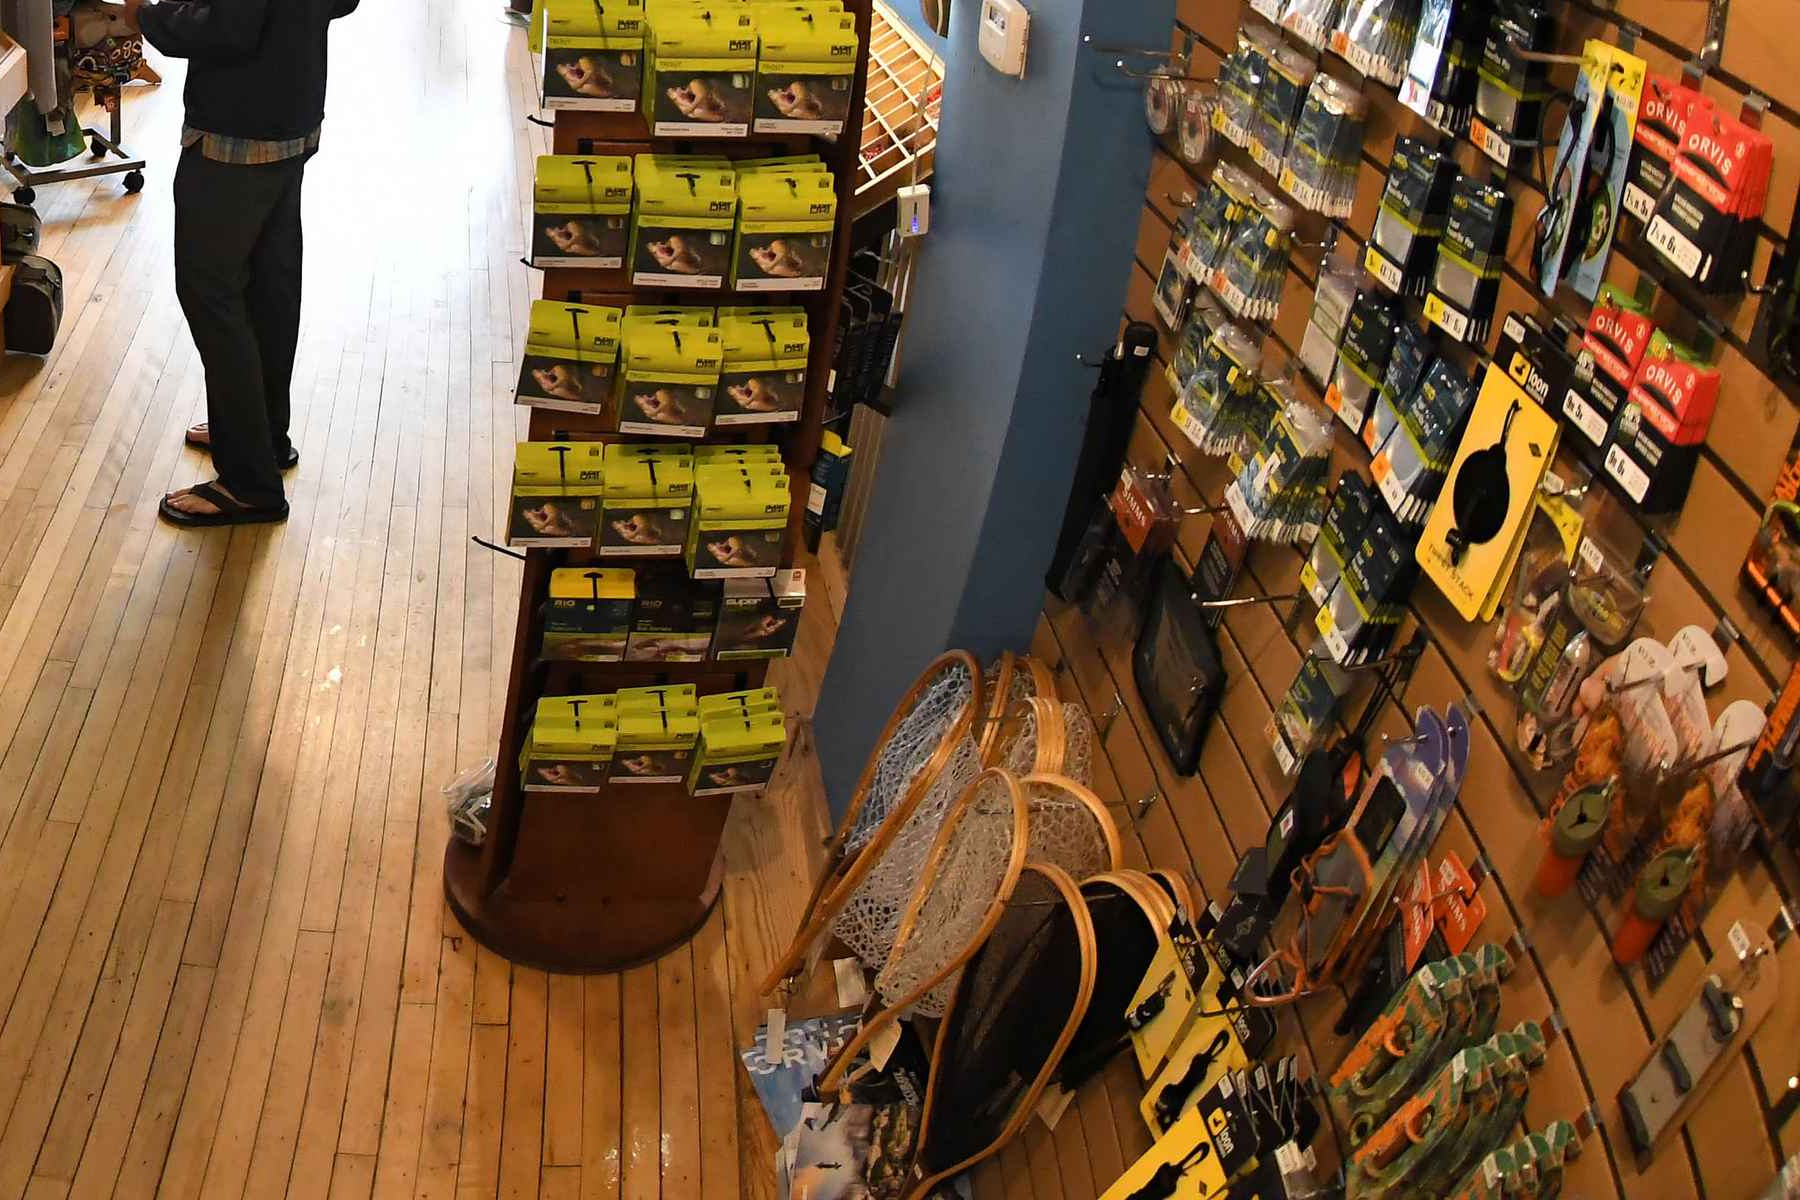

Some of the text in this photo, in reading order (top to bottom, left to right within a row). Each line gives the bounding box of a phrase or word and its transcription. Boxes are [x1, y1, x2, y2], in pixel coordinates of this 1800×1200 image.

[1646, 100, 1686, 135] ORVIS
[1688, 133, 1732, 176] ORVIS
[1595, 314, 1635, 354] ORVIS
[1528, 367, 1549, 398] loon
[1645, 364, 1684, 407] ORVIS
